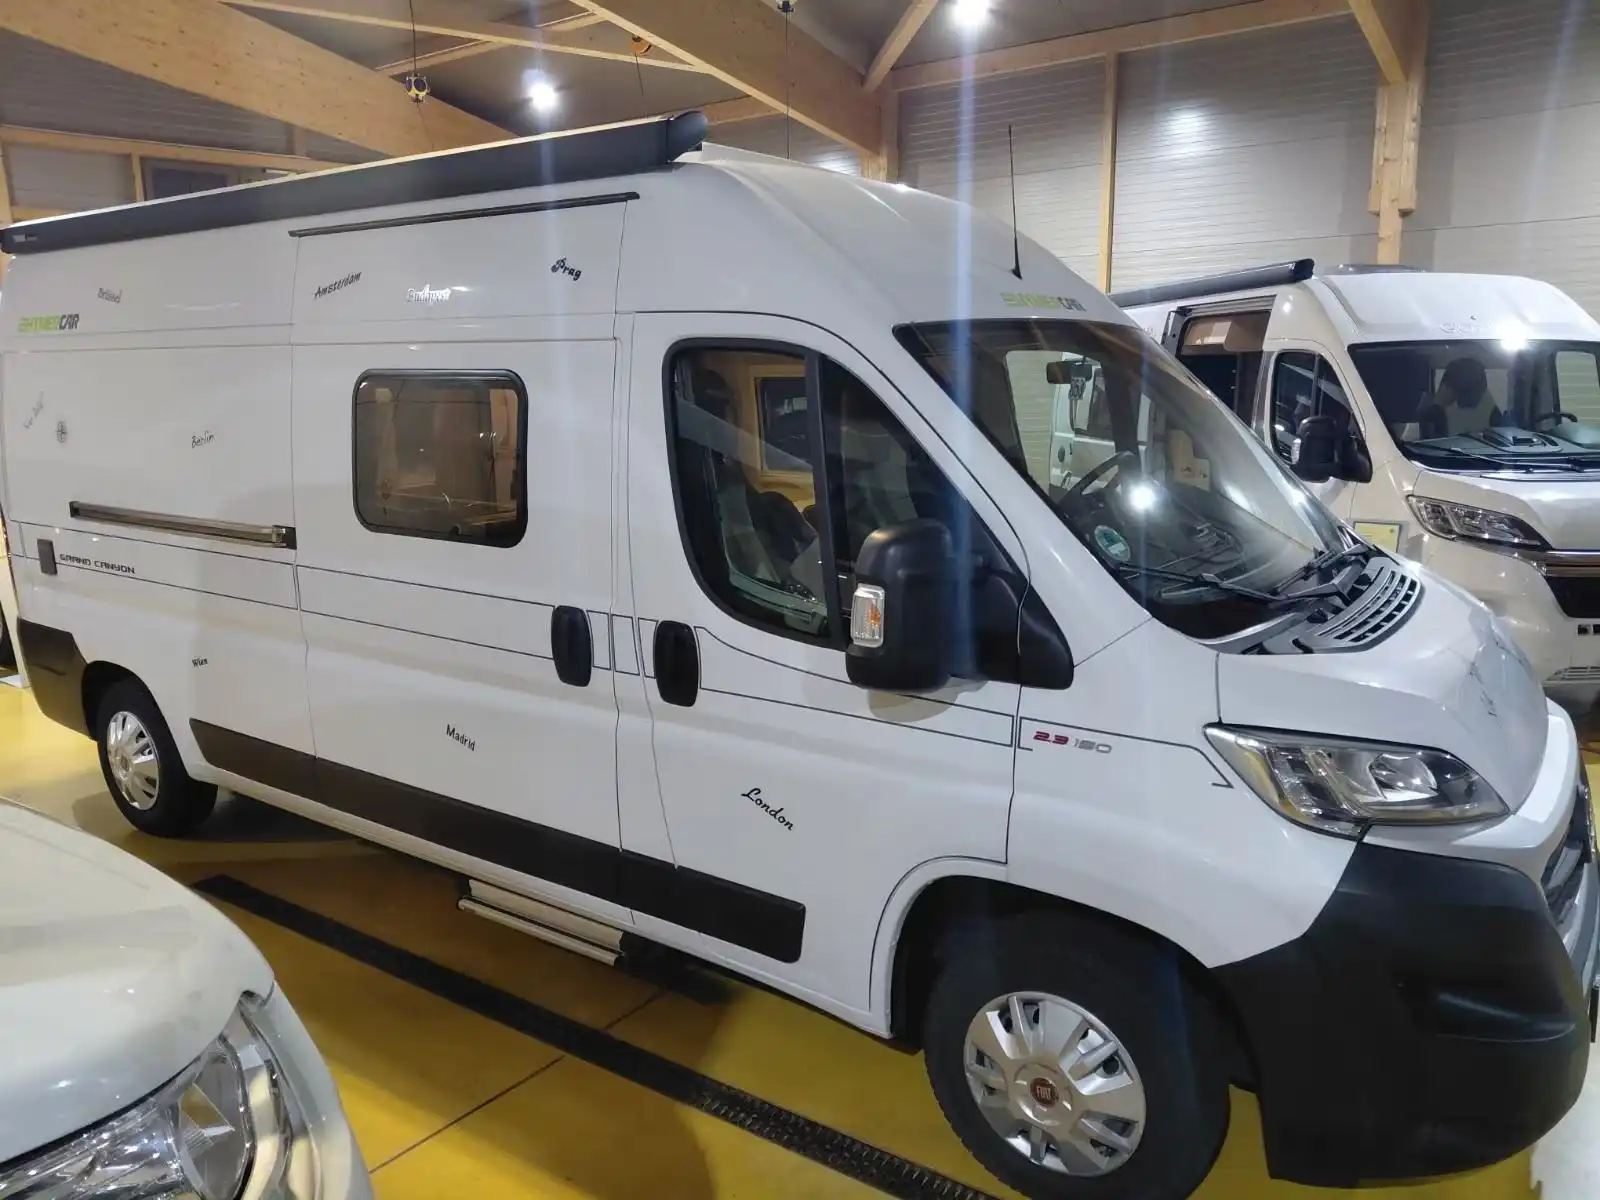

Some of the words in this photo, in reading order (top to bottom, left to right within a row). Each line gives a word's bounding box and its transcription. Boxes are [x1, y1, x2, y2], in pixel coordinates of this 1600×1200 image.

[551, 257, 581, 281] Prag
[314, 271, 362, 300] Amsterdam
[59, 553, 92, 566] GRAND
[94, 560, 136, 574] CANYON
[446, 723, 476, 752] Madrid
[740, 787, 794, 831] London
